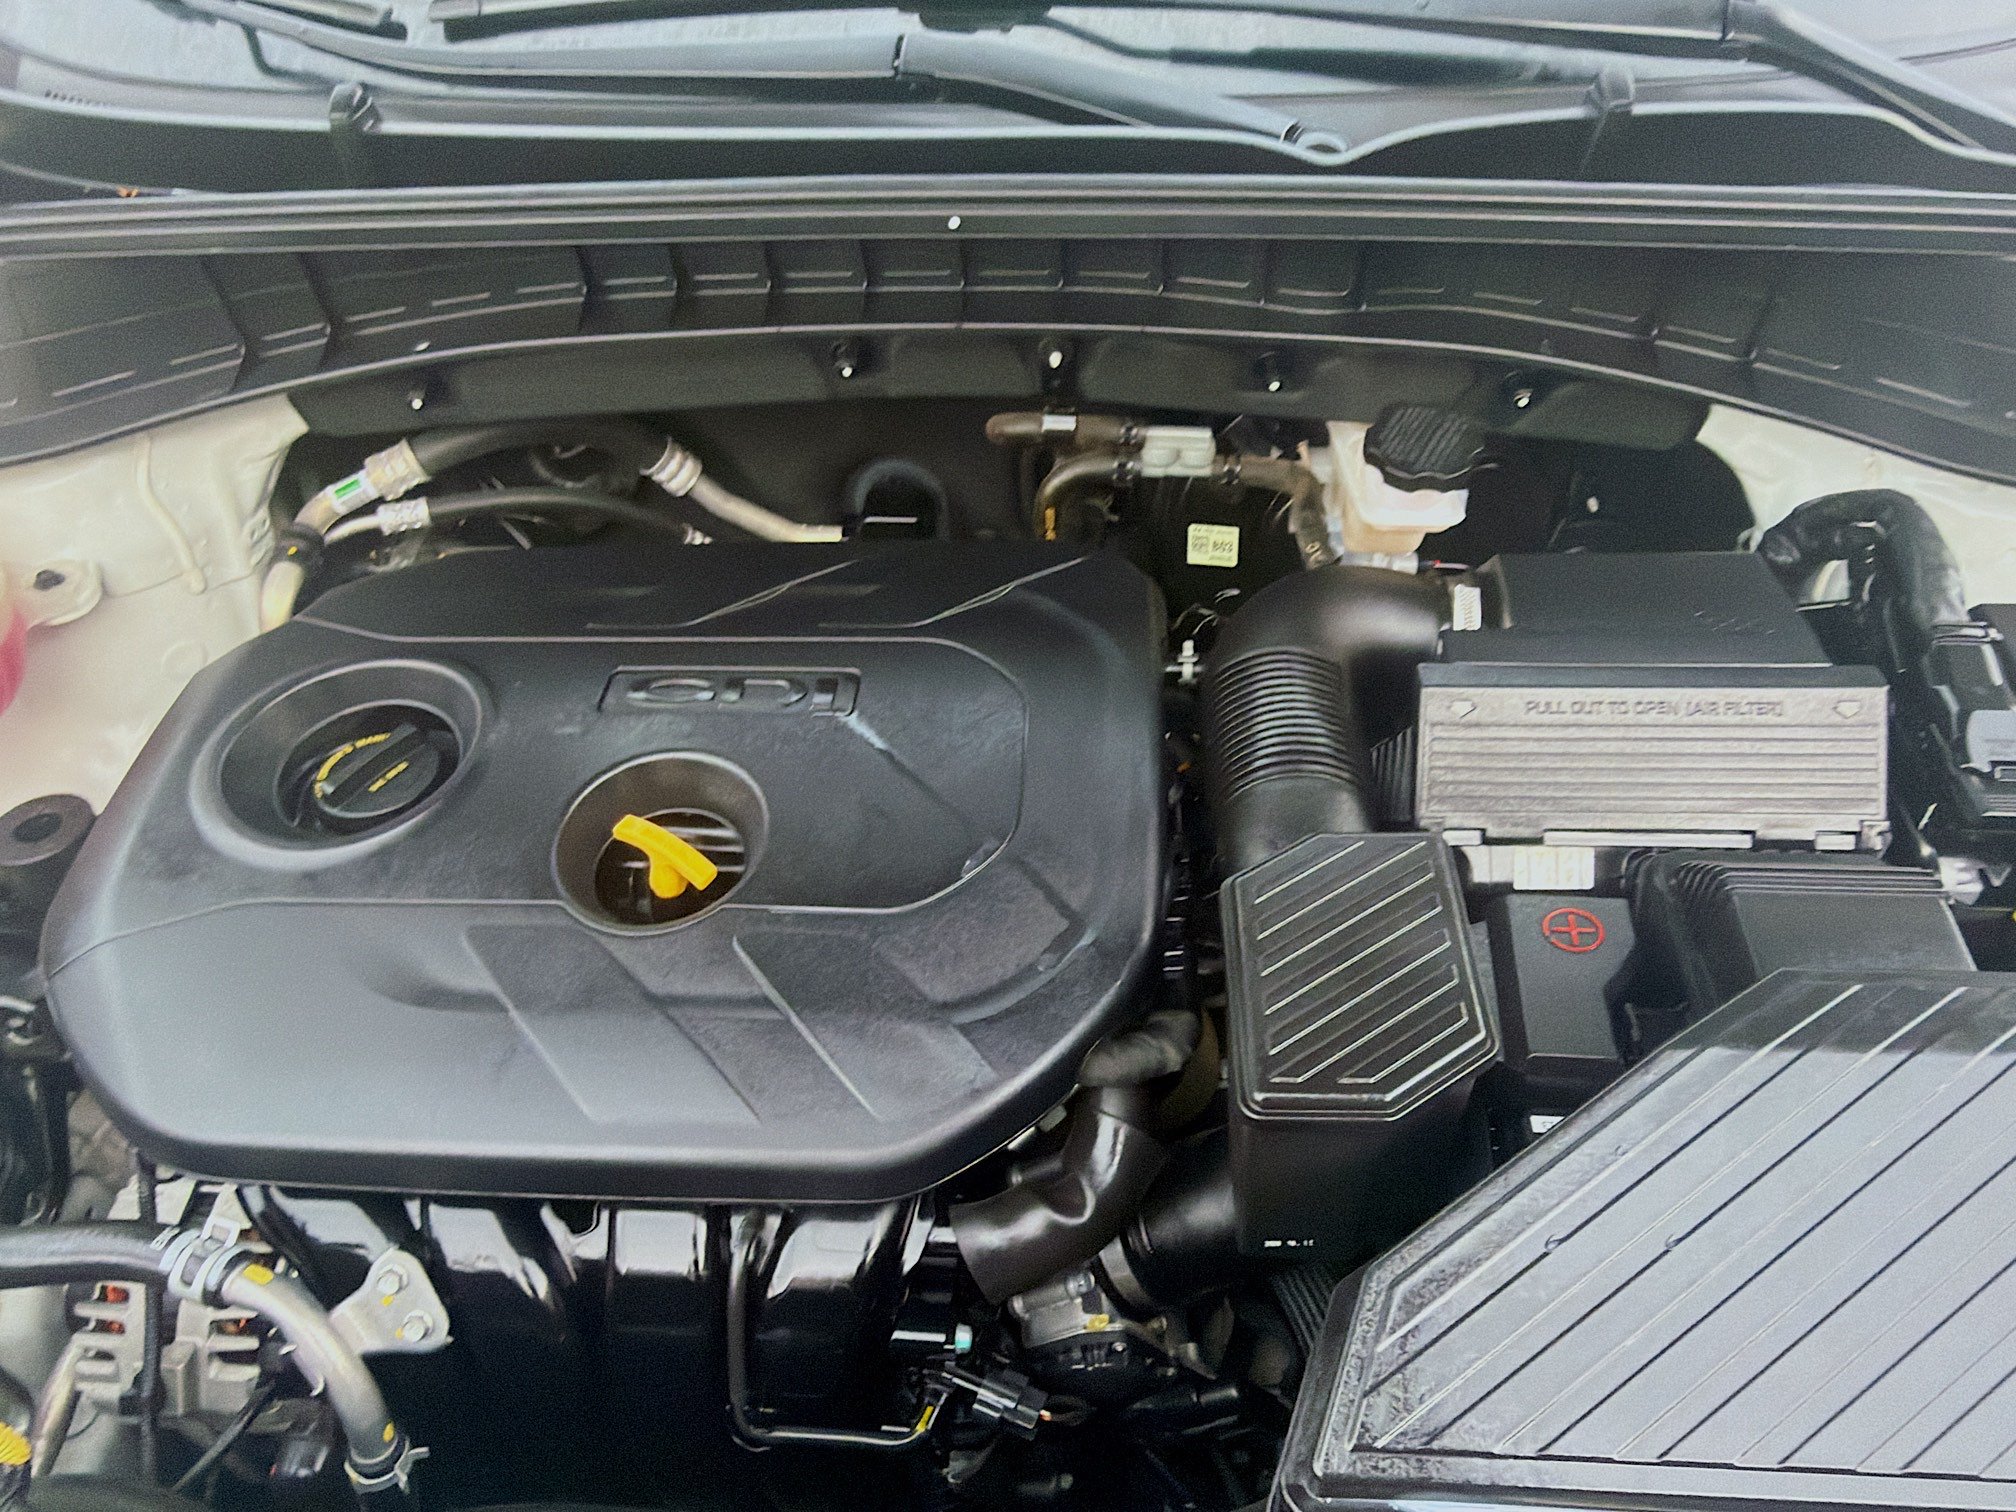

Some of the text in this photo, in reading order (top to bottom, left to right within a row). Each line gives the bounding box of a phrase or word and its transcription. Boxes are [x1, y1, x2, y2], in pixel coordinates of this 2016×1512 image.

[1524, 700, 1568, 716] PULL
[1571, 700, 1604, 715] OUT
[1607, 700, 1629, 716] TO
[1635, 700, 1678, 716] OPEN
